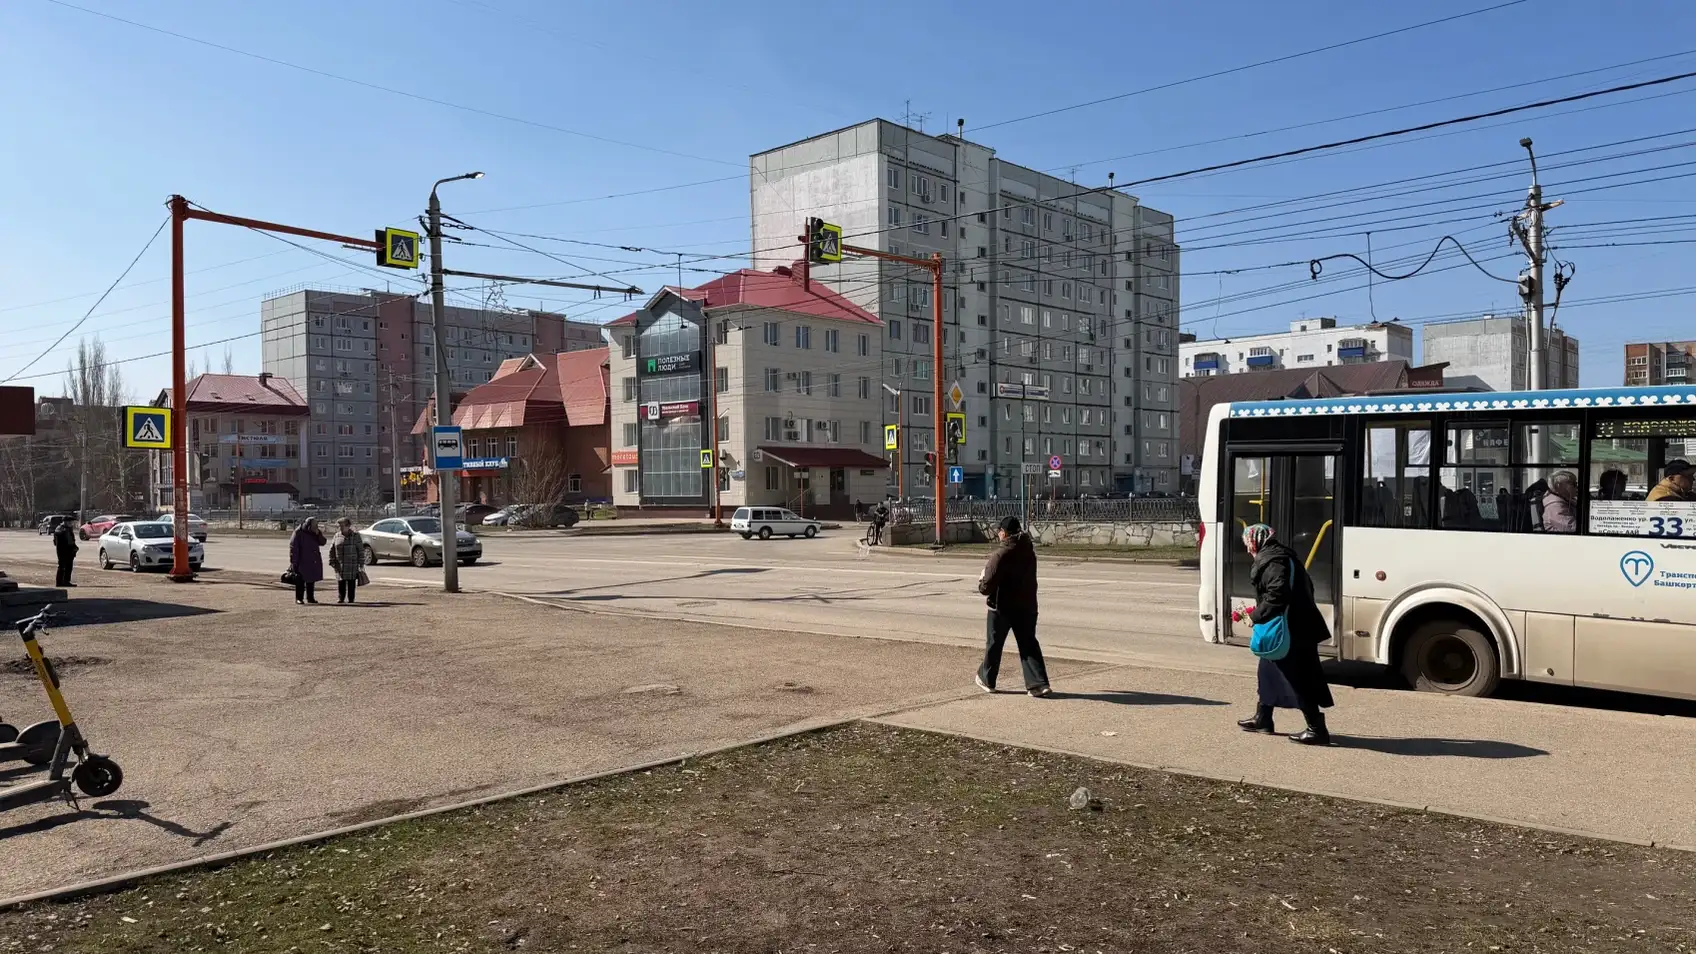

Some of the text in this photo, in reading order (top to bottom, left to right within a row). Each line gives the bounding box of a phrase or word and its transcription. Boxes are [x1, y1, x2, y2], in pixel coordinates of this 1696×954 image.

[657, 355, 690, 364] ПОЛЕЗНЫЕ
[657, 363, 677, 372] ЛЮДИ
[1025, 465, 1041, 473] СТОП
[1649, 516, 1684, 536] 33
